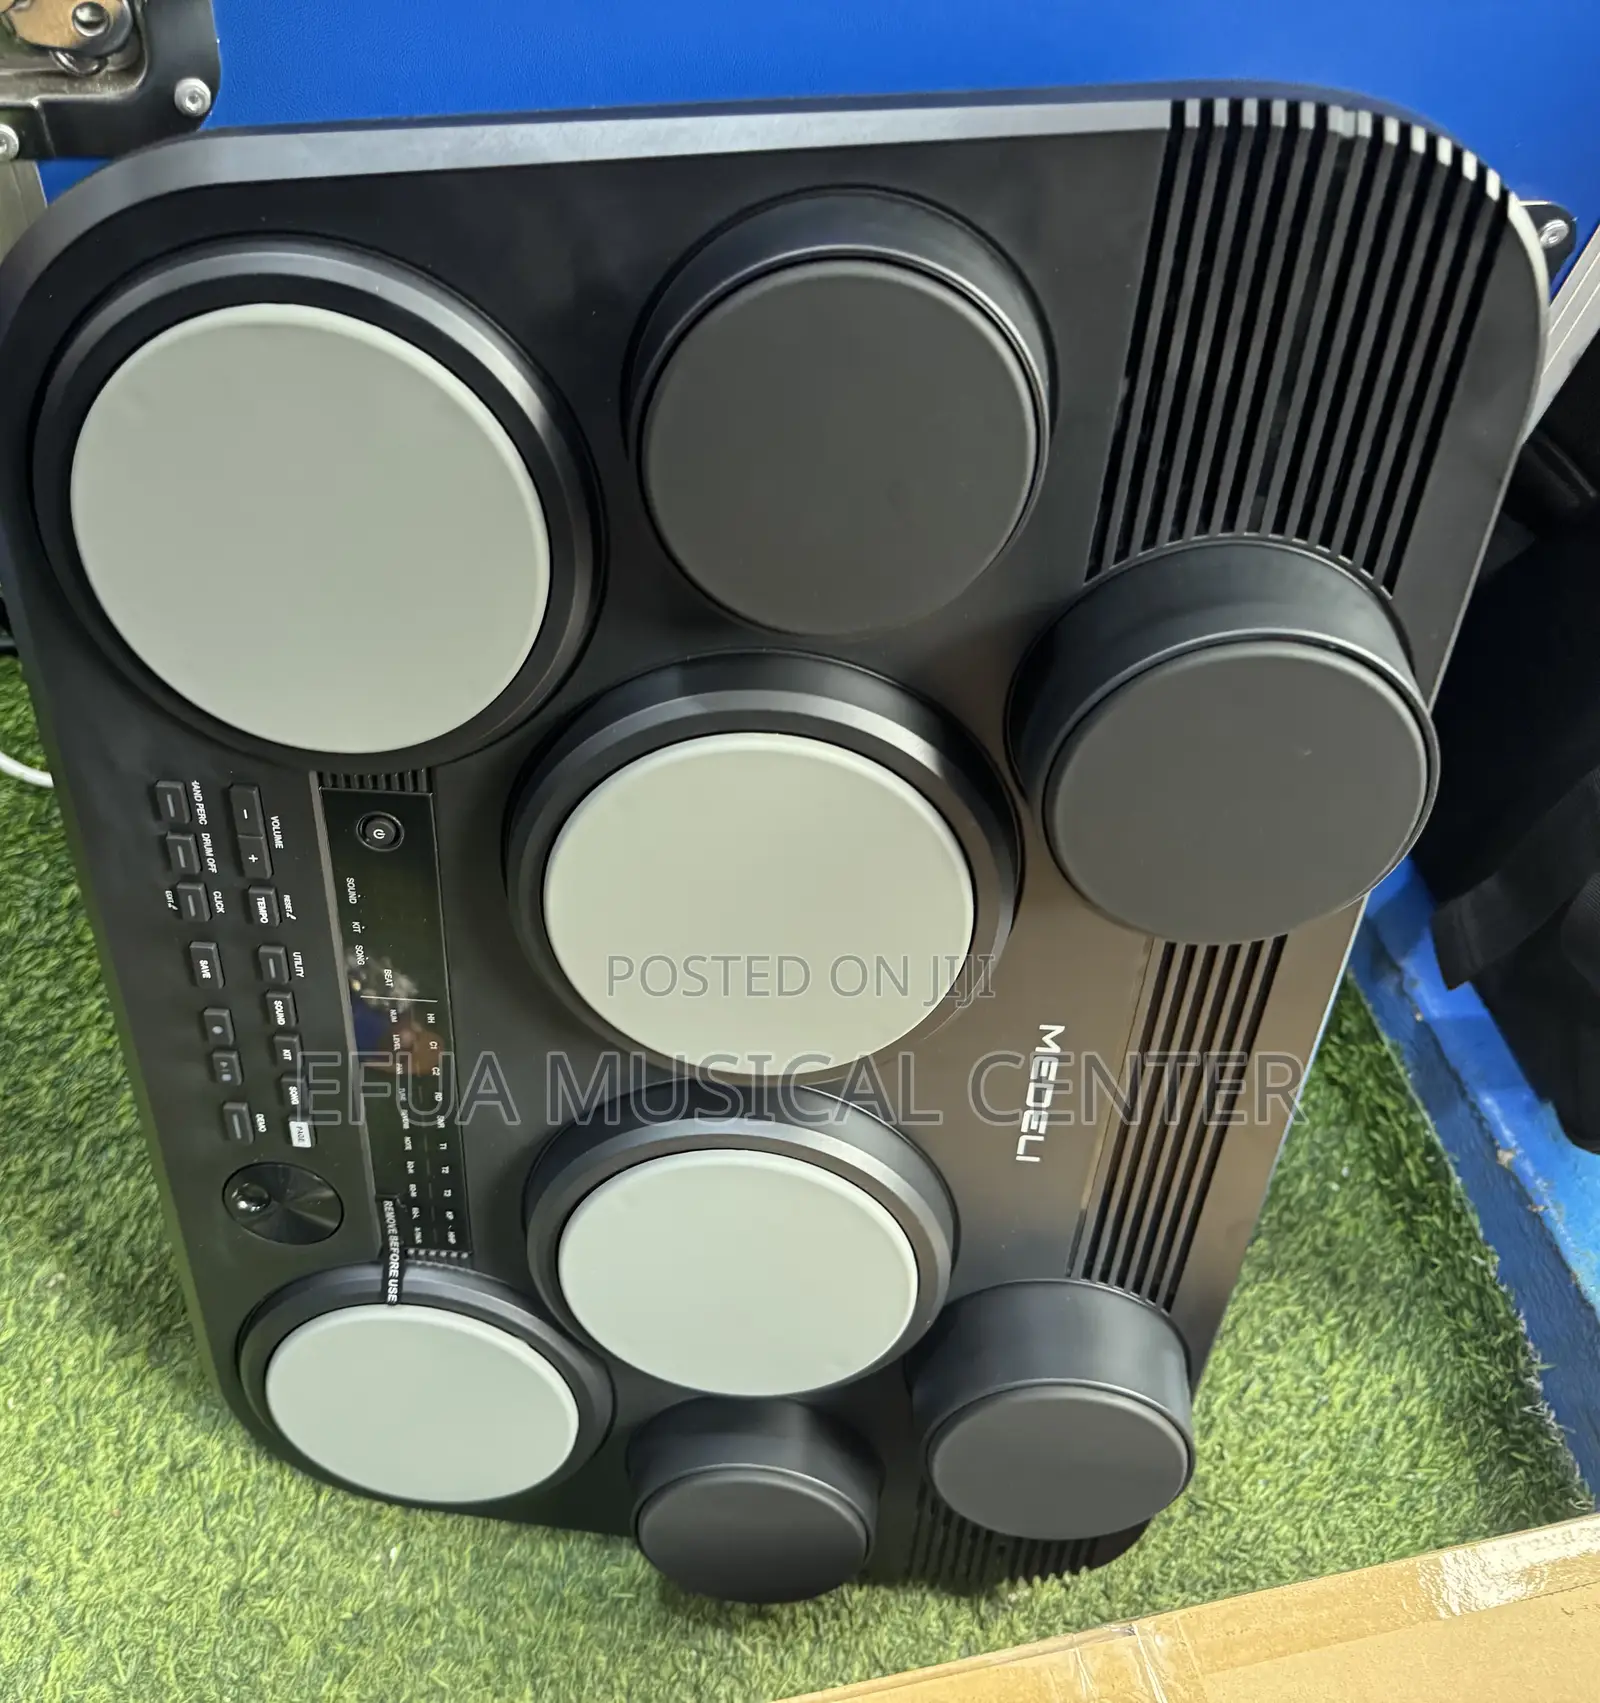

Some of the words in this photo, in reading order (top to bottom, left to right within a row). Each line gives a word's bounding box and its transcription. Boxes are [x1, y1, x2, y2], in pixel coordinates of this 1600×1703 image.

[195, 803, 208, 825] PERC
[270, 816, 284, 849] VOLUME
[201, 833, 214, 857] DRUM
[206, 858, 218, 874] OFF
[346, 877, 357, 904] SOUND
[213, 890, 225, 914] CLICK
[256, 896, 269, 924] TEMPO
[283, 894, 293, 914] RESET
[352, 921, 361, 934] KIT
[292, 951, 304, 978] UTILITY
[355, 944, 365, 966] SONG
[199, 959, 211, 979] SAVE
[384, 969, 394, 987] BEAT
[274, 1000, 285, 1026] SOUND
[390, 1009, 398, 1023] NUM
[427, 1013, 435, 1024] HH
[282, 1049, 292, 1061] KIT
[429, 1041, 438, 1050] C1
[432, 1067, 440, 1076] C2
[289, 1086, 299, 1105] SONG
[1016, 1024, 1065, 1162] MEDELI
[255, 1113, 267, 1133] DEMO
[440, 1142, 447, 1150] T1
[383, 1200, 398, 1235] REMOVE
[388, 1235, 400, 1278] BEFORE
[387, 1278, 399, 1304] USE
